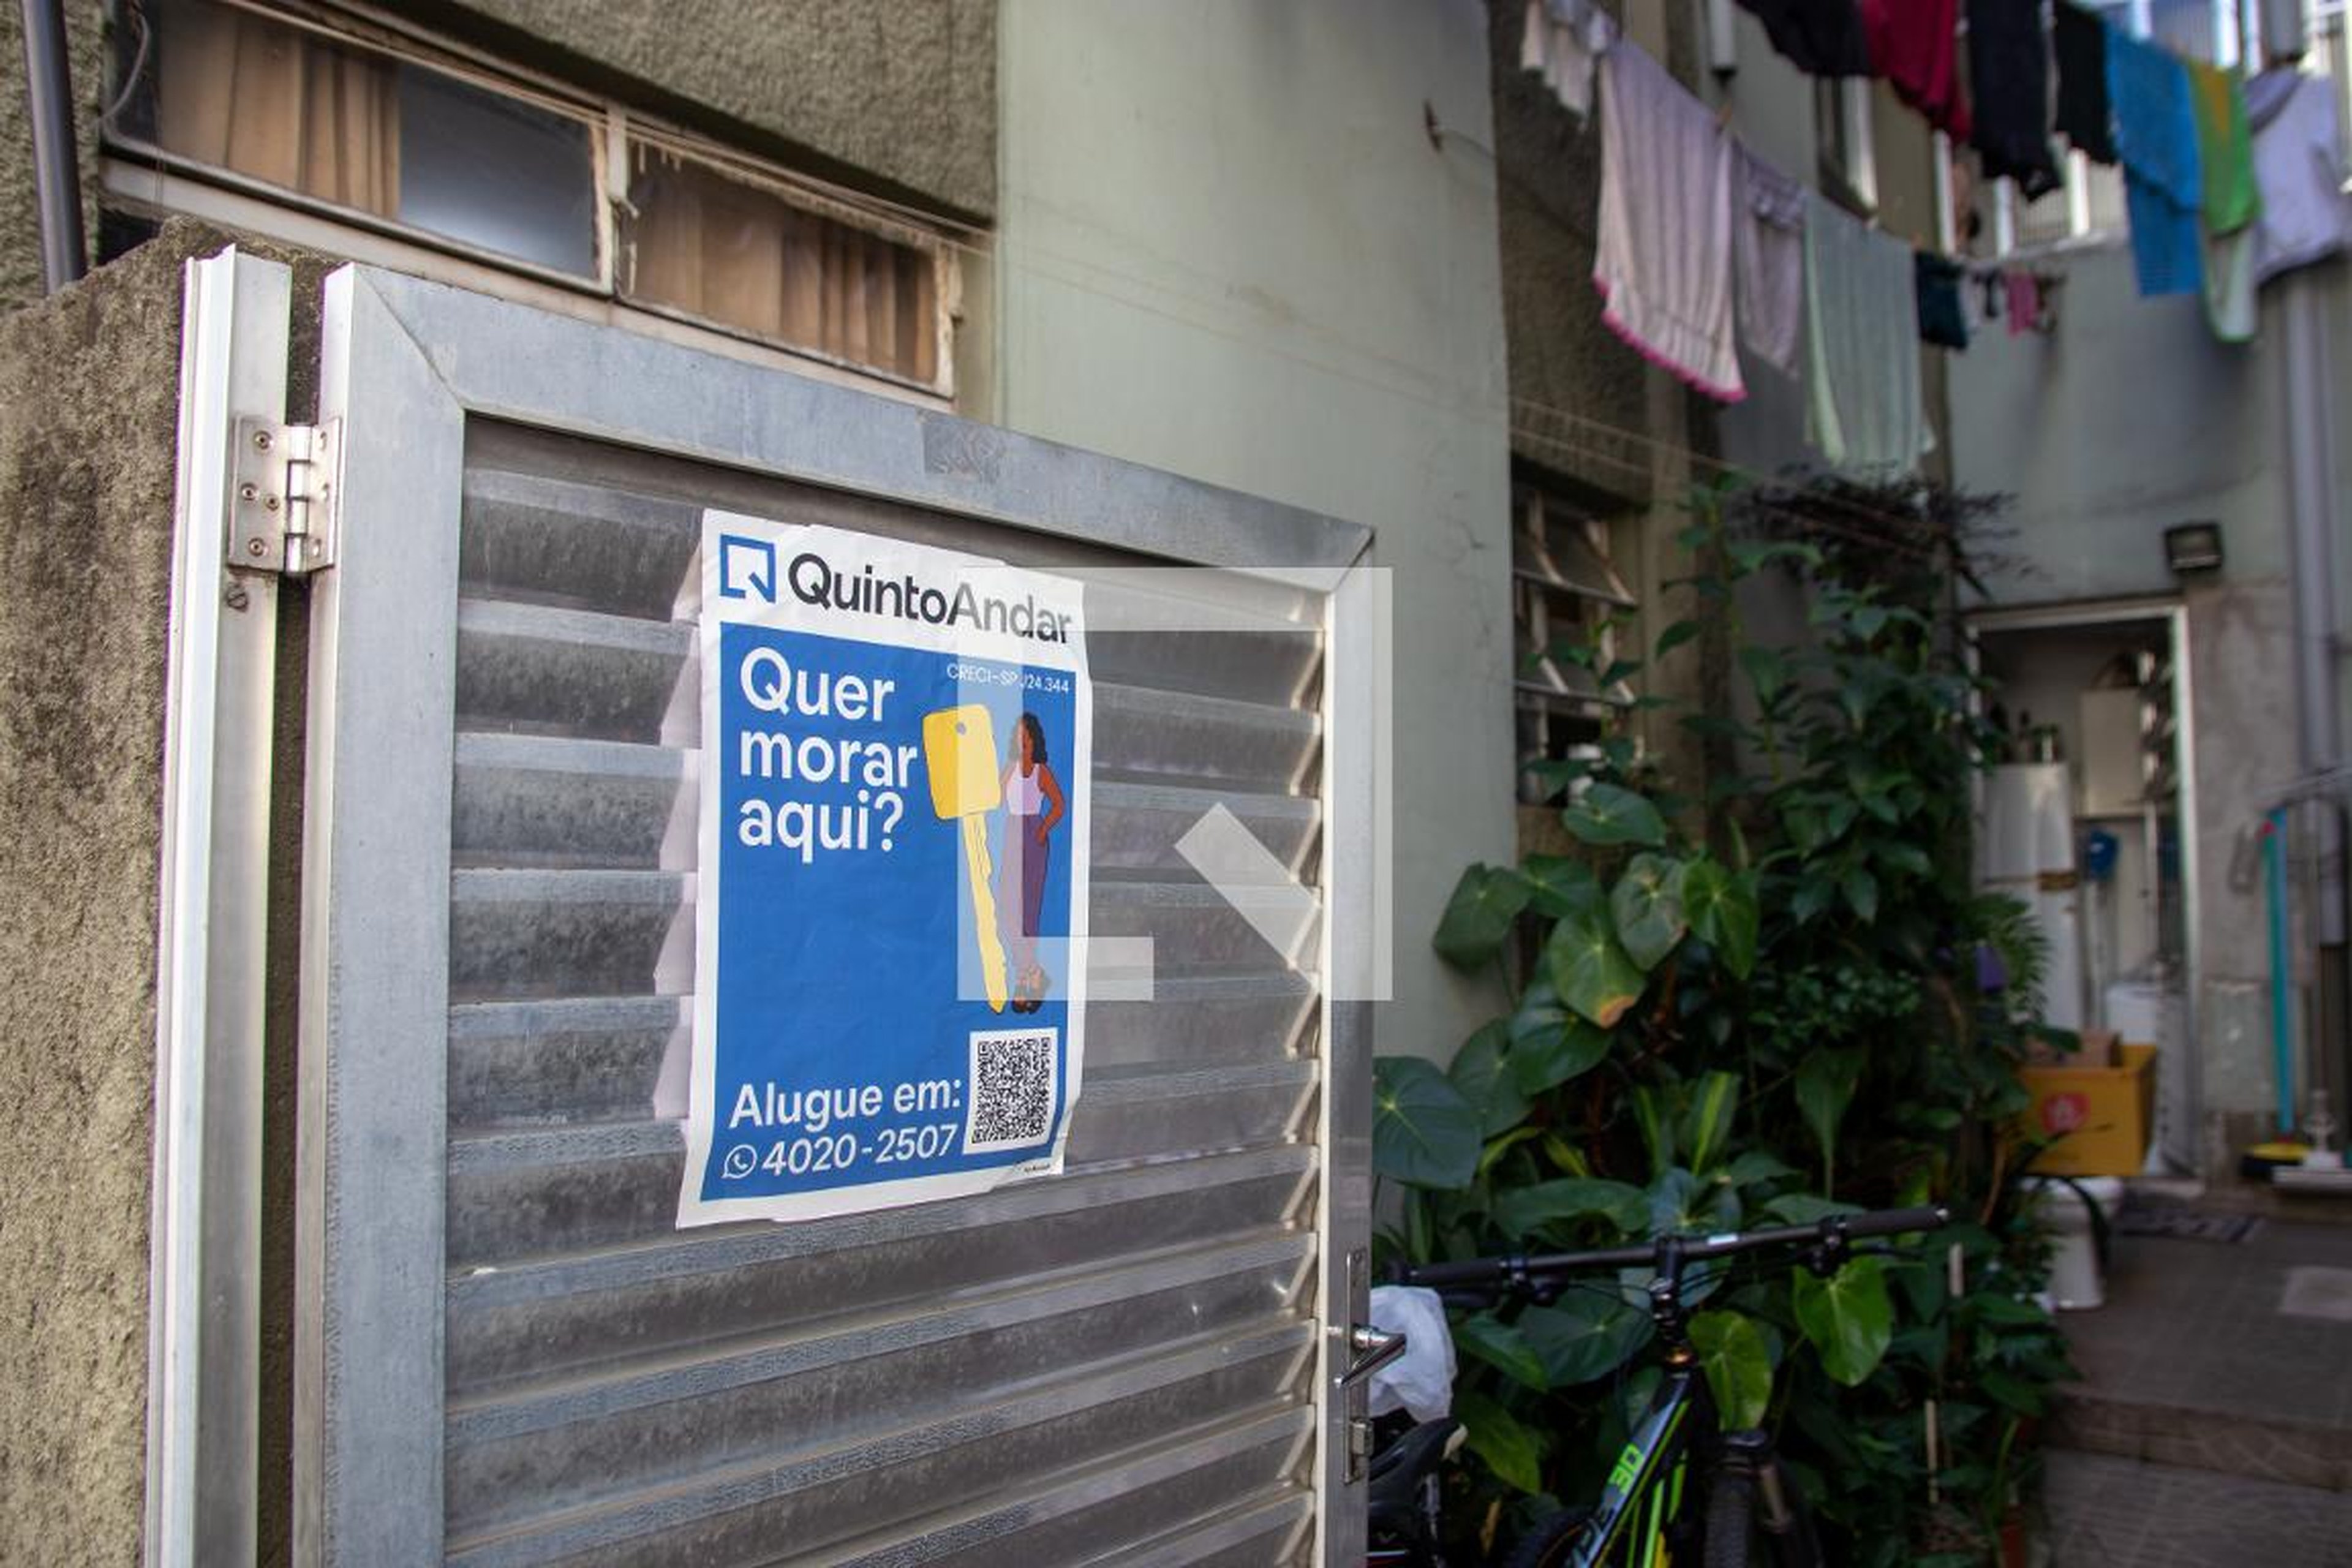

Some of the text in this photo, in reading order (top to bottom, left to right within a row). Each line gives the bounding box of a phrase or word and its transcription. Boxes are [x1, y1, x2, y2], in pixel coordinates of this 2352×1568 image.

[788, 553, 1072, 644] QuintoAndar
[741, 647, 894, 722] Quer
[740, 730, 918, 788] morar
[739, 790, 904, 864] aqui?
[729, 1077, 962, 1132] Alugue em:
[762, 1124, 958, 1176] 4020-2507
